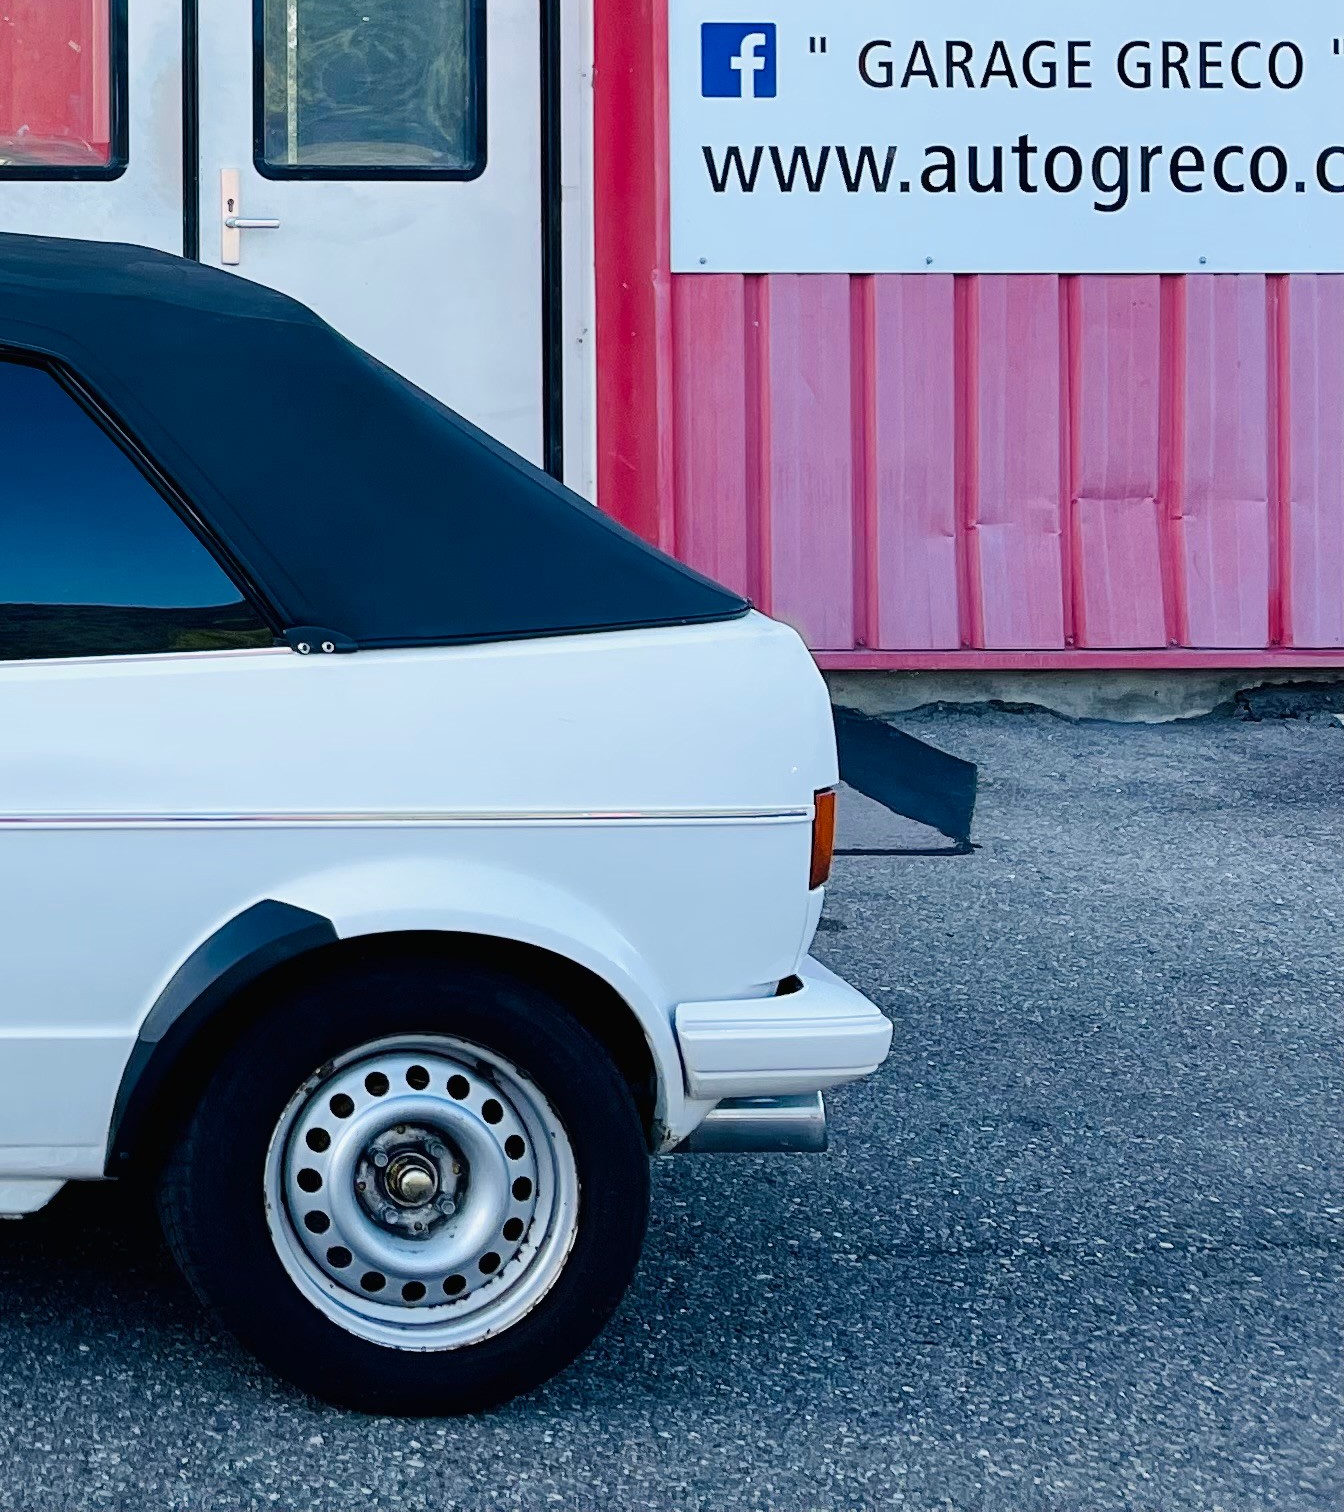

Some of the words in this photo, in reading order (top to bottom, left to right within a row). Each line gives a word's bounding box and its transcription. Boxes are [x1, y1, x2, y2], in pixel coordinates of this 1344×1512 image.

[859, 40, 1092, 88] GARAGE
[1117, 41, 1303, 89] GRECO
[702, 134, 1344, 212] www.autogreco.c
